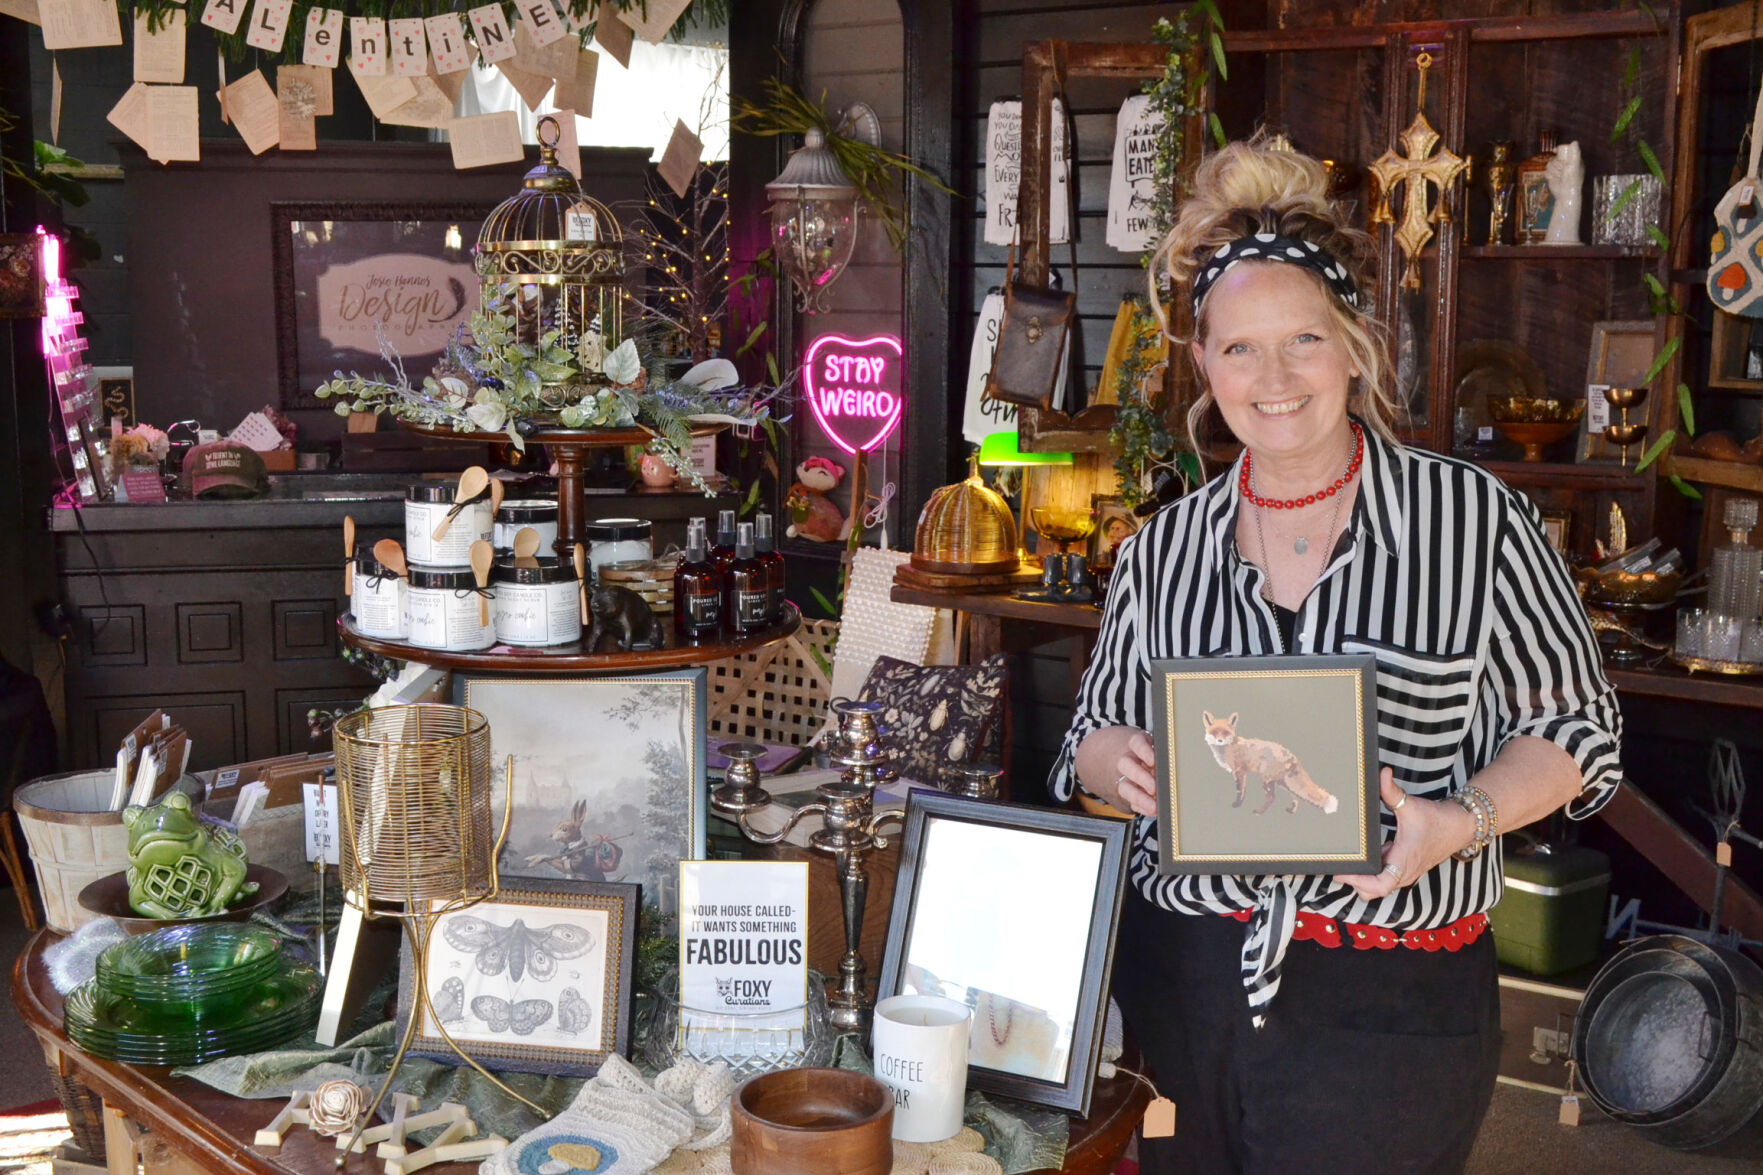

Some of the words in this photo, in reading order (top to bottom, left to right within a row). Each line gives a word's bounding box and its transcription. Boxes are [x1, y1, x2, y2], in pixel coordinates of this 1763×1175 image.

[1127, 218, 1148, 232] FEW
[339, 283, 444, 337] Design
[825, 354, 885, 384] STAY
[692, 905, 718, 917] YOUR
[720, 905, 752, 917] HOUSE
[692, 921, 701, 932] IT
[704, 921, 737, 933] WANTS
[740, 921, 797, 933] SOMETHING
[686, 938, 802, 966] FABULOUS
[734, 980, 772, 998] FOXY
[725, 996, 771, 1006] Curations
[880, 1053, 924, 1083] COFFEE
